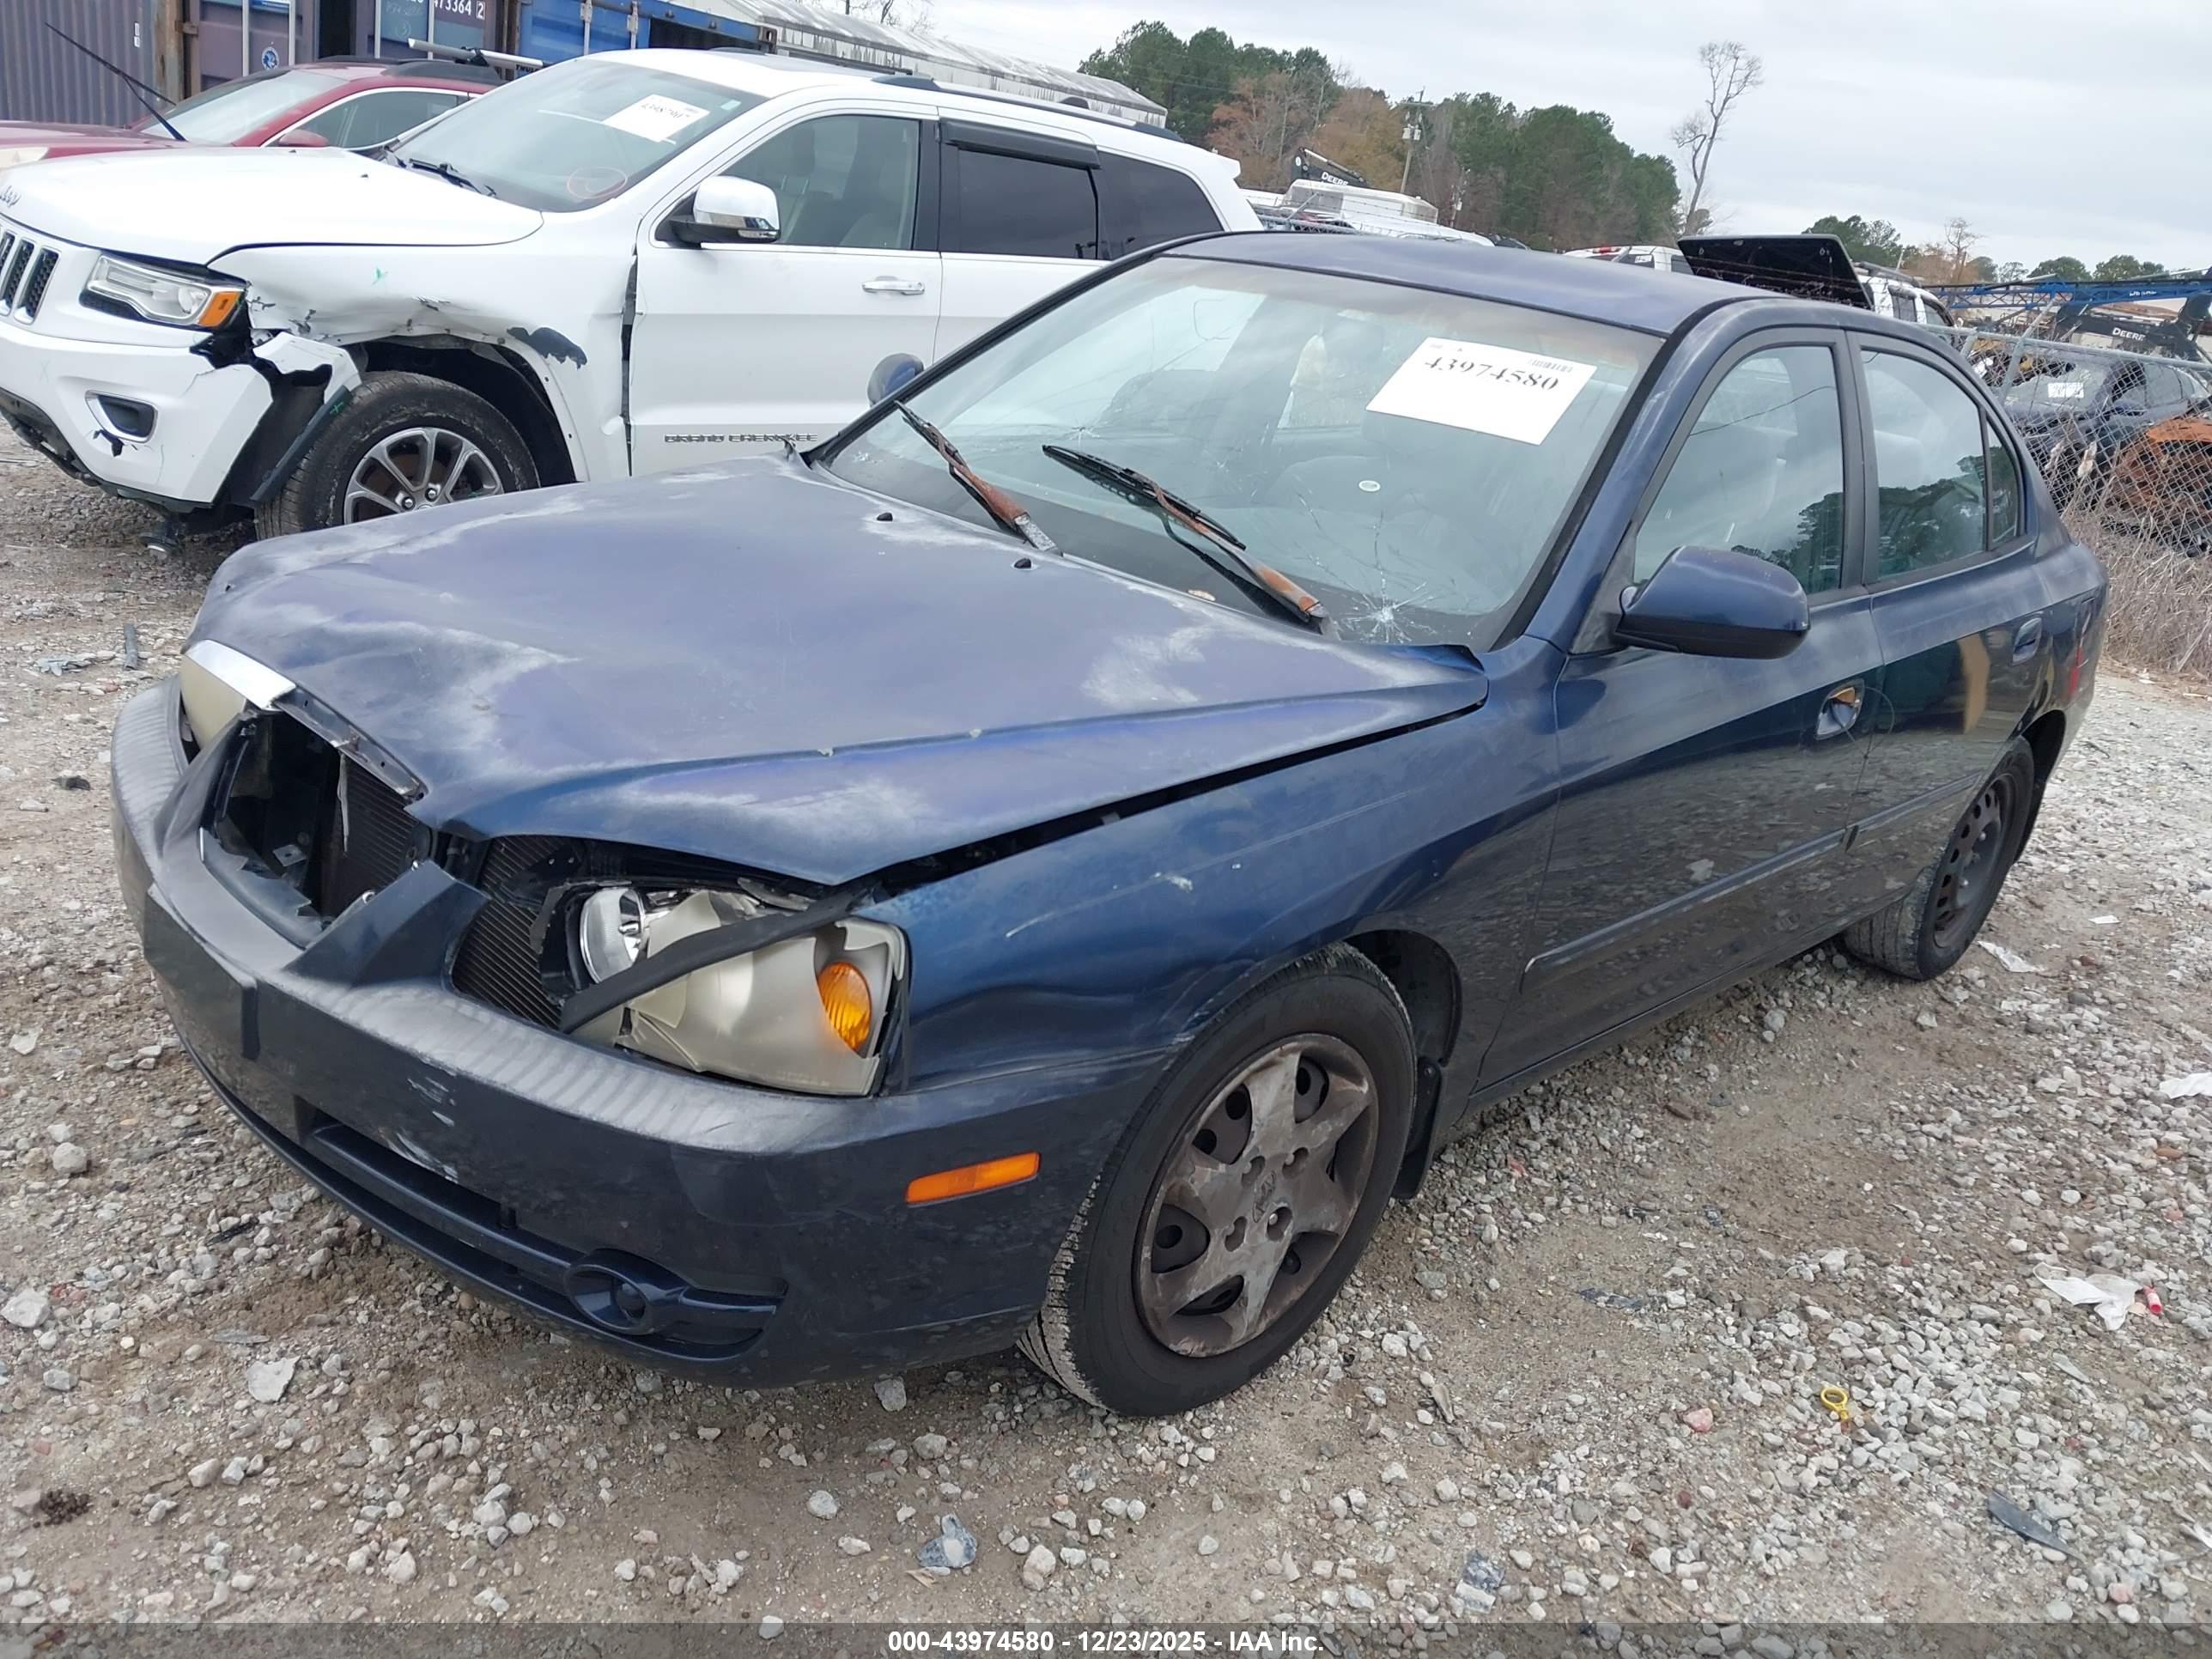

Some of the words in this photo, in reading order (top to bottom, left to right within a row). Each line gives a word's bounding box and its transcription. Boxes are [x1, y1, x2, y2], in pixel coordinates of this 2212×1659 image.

[1322, 171, 1349, 185] DEERE
[2112, 327, 2146, 341] DEERE
[1424, 356, 1559, 390] 43974580
[665, 434, 725, 443] GRAND
